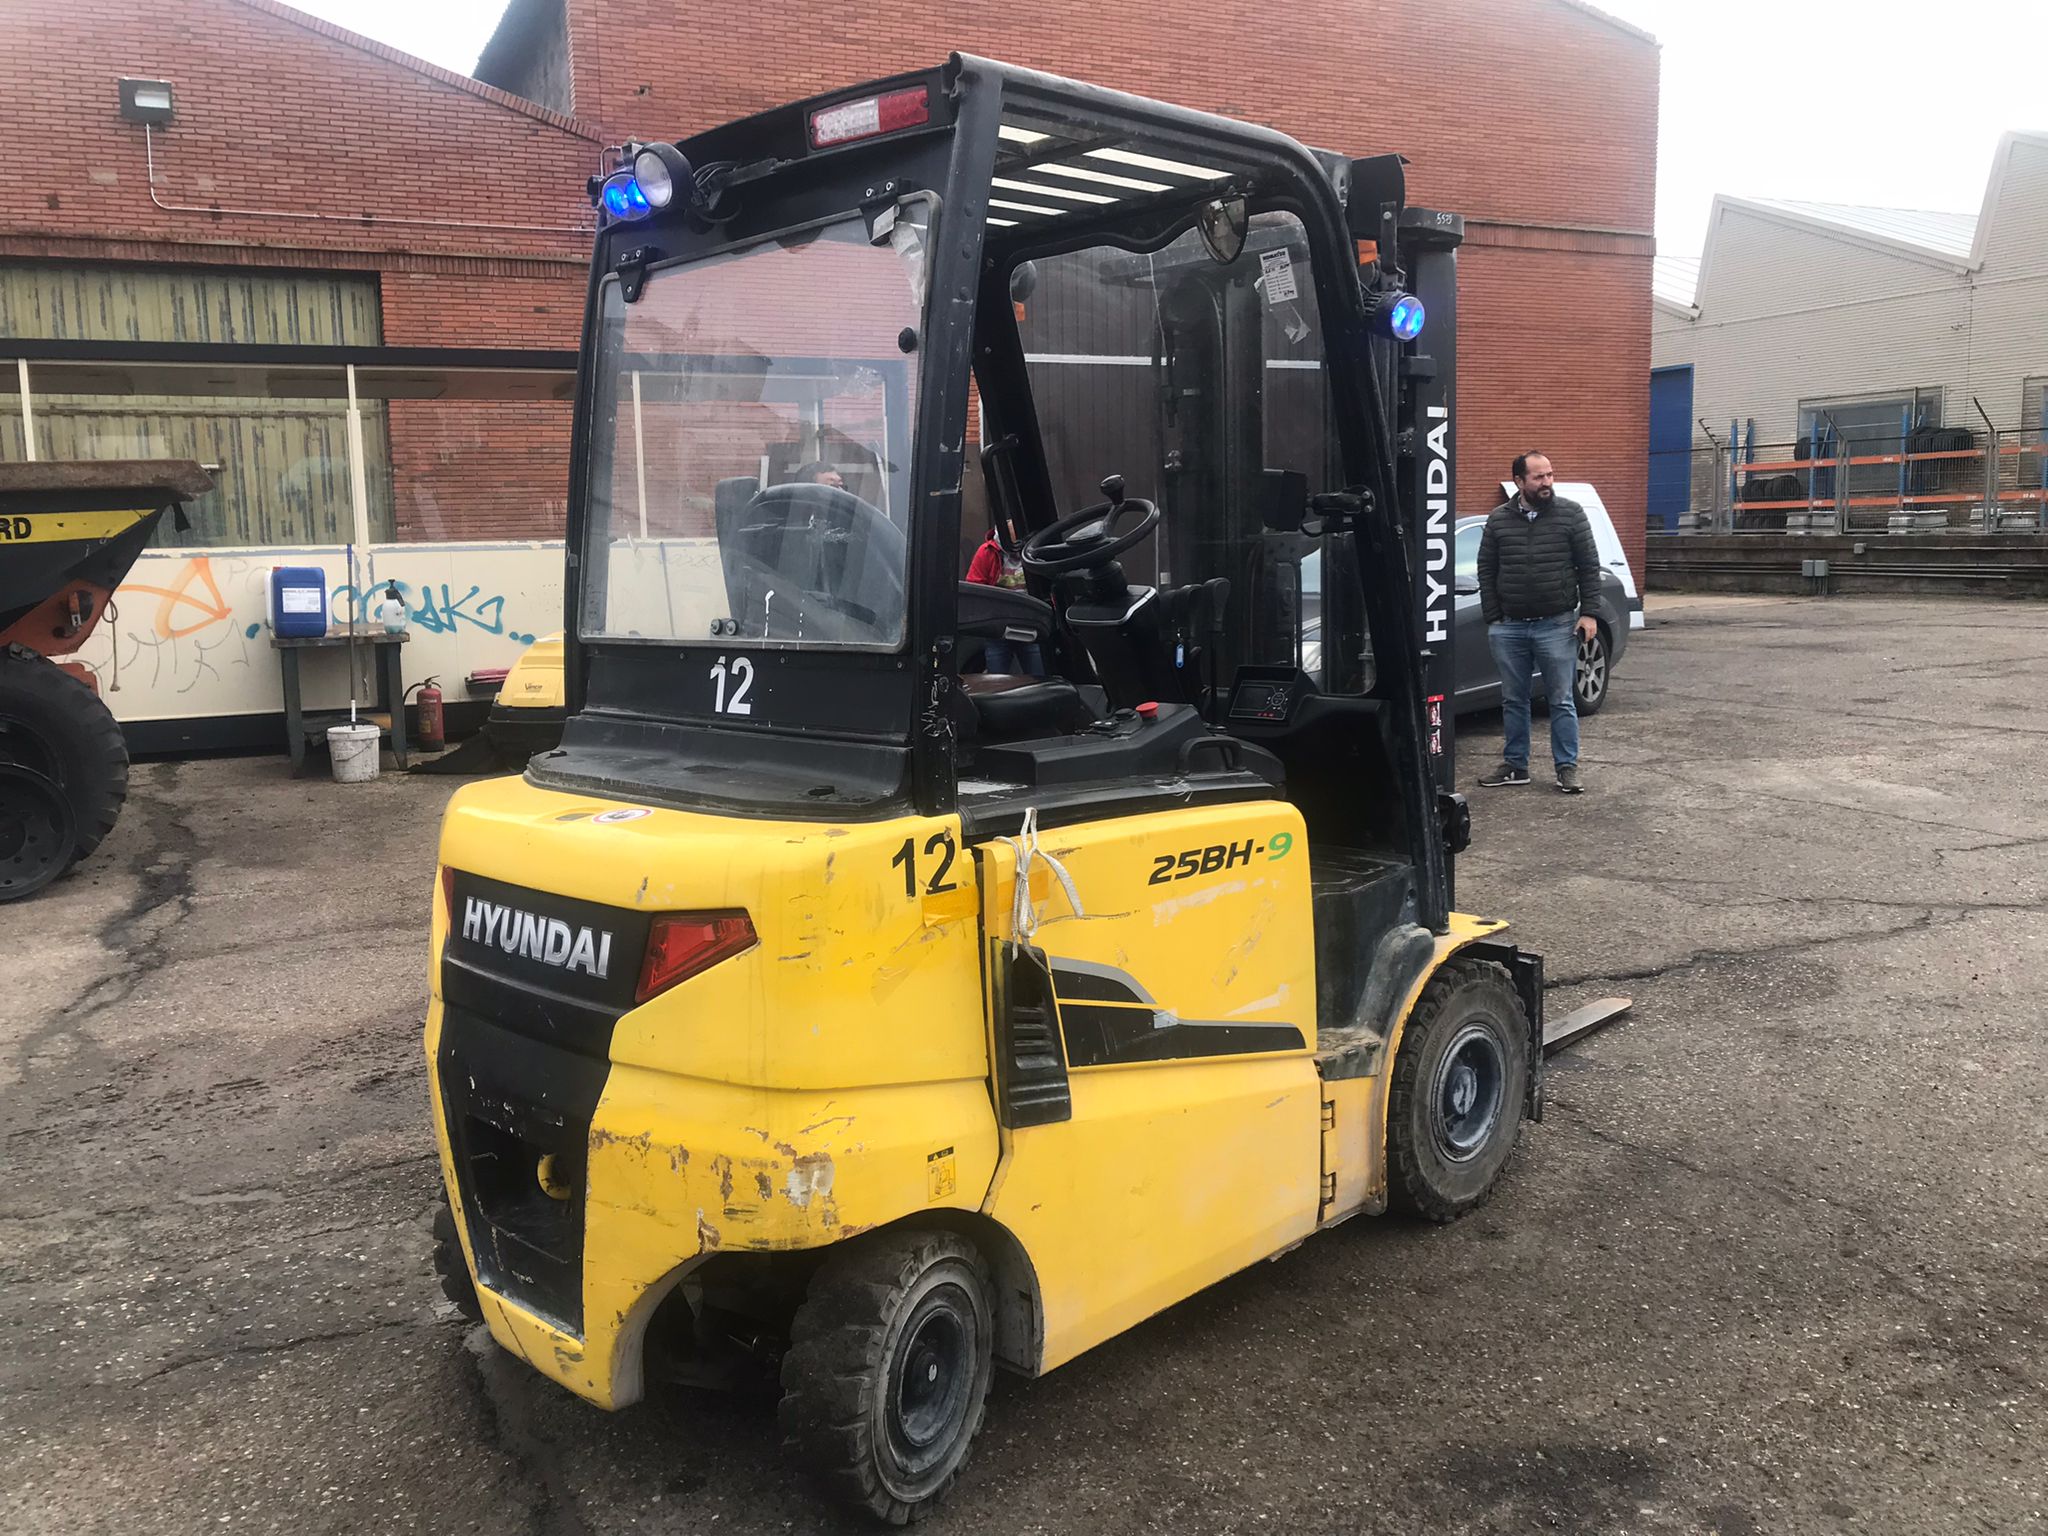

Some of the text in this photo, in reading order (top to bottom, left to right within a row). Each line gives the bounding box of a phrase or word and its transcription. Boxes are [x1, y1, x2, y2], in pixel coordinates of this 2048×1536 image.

[0, 517, 32, 540] RD
[1426, 406, 1448, 642] HYUNDAI
[709, 655, 755, 715] 12
[892, 832, 957, 898] 12
[1148, 832, 1293, 886] 25BH-9
[462, 896, 613, 979] HYUNDAI
